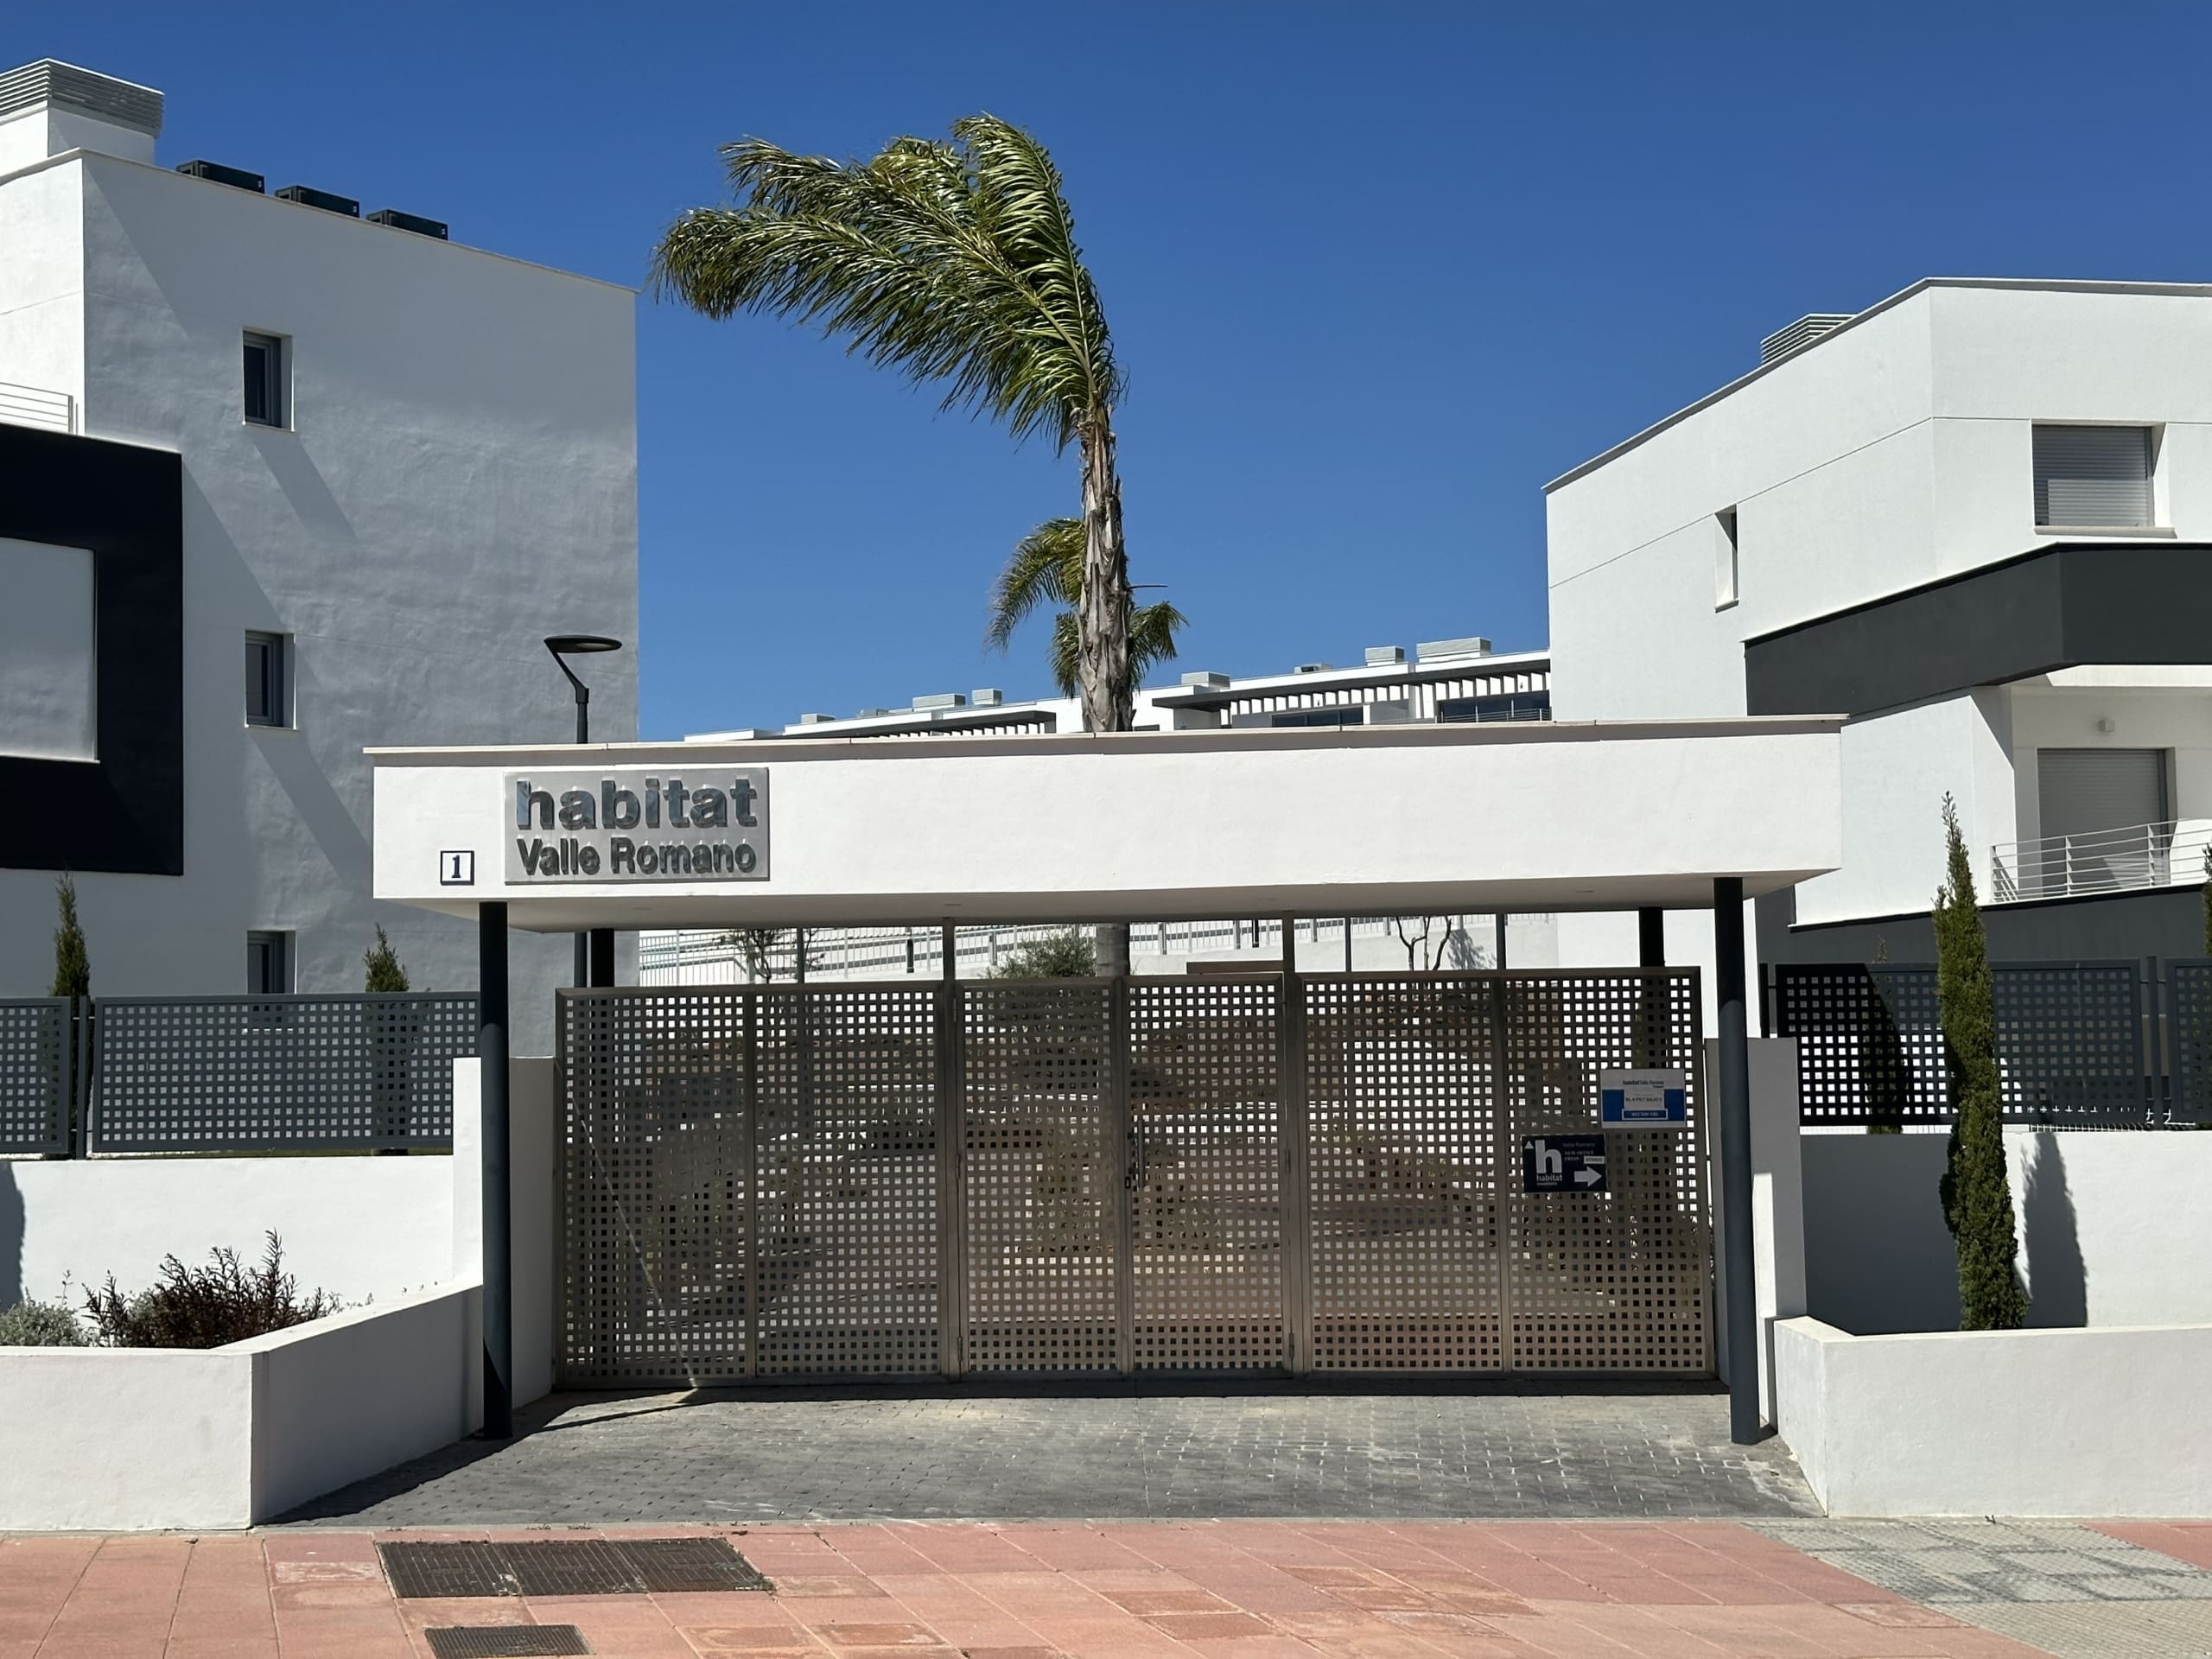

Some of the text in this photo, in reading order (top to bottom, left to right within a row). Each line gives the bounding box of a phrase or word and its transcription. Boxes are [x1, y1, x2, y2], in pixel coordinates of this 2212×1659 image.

[516, 778, 758, 830] habitat
[450, 854, 462, 879] 1
[516, 836, 757, 875] Valle Romano
[1535, 1139, 1562, 1174] h
[1536, 1173, 1563, 1182] habitat
